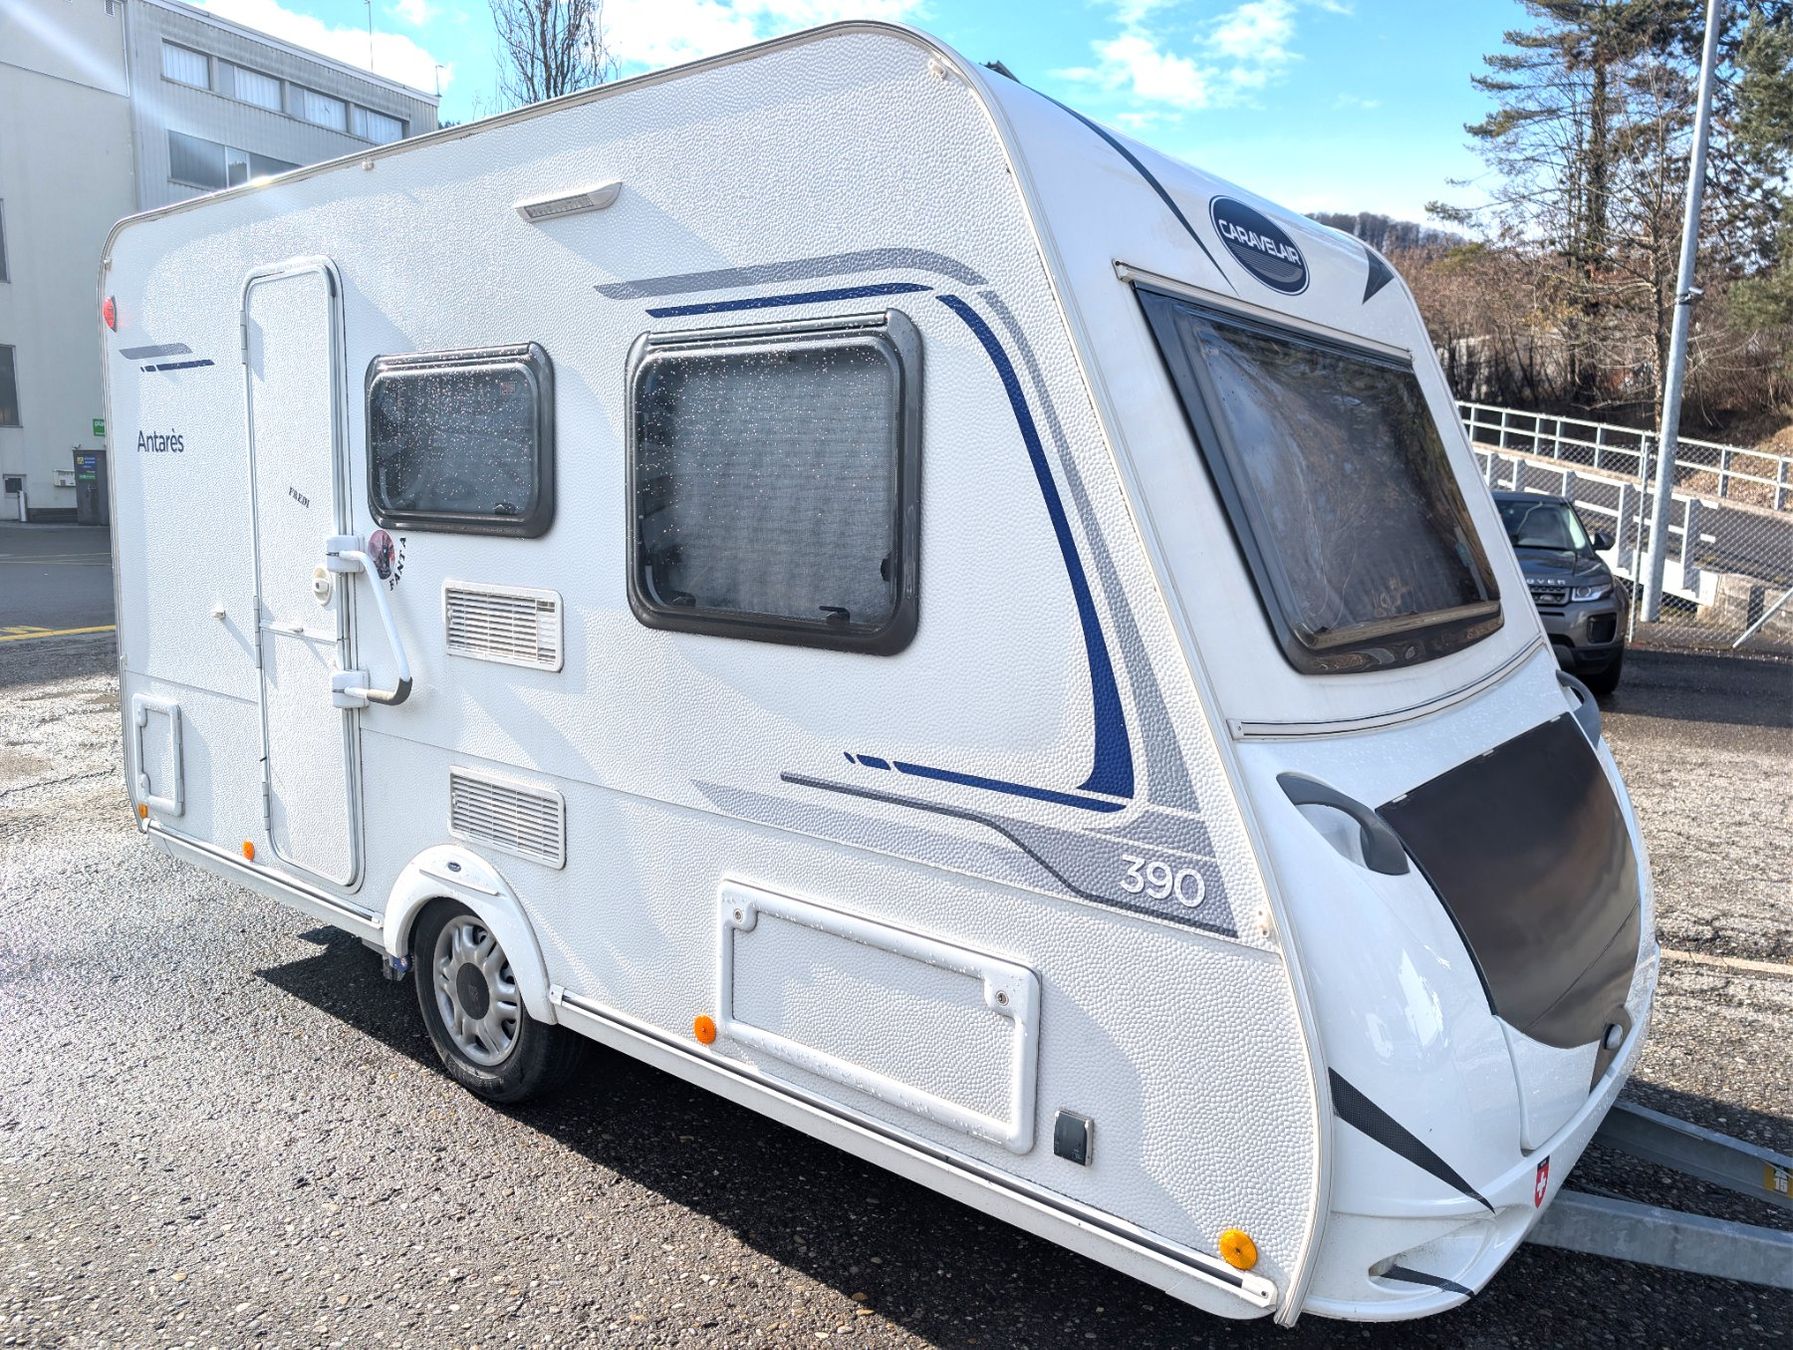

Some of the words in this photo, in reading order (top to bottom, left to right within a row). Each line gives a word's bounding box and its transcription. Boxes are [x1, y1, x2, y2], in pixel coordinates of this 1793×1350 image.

[1218, 219, 1302, 265] CARAVELAIR
[137, 428, 184, 453] Antarès
[1526, 578, 1566, 587] OVER
[1120, 854, 1206, 908] 390
